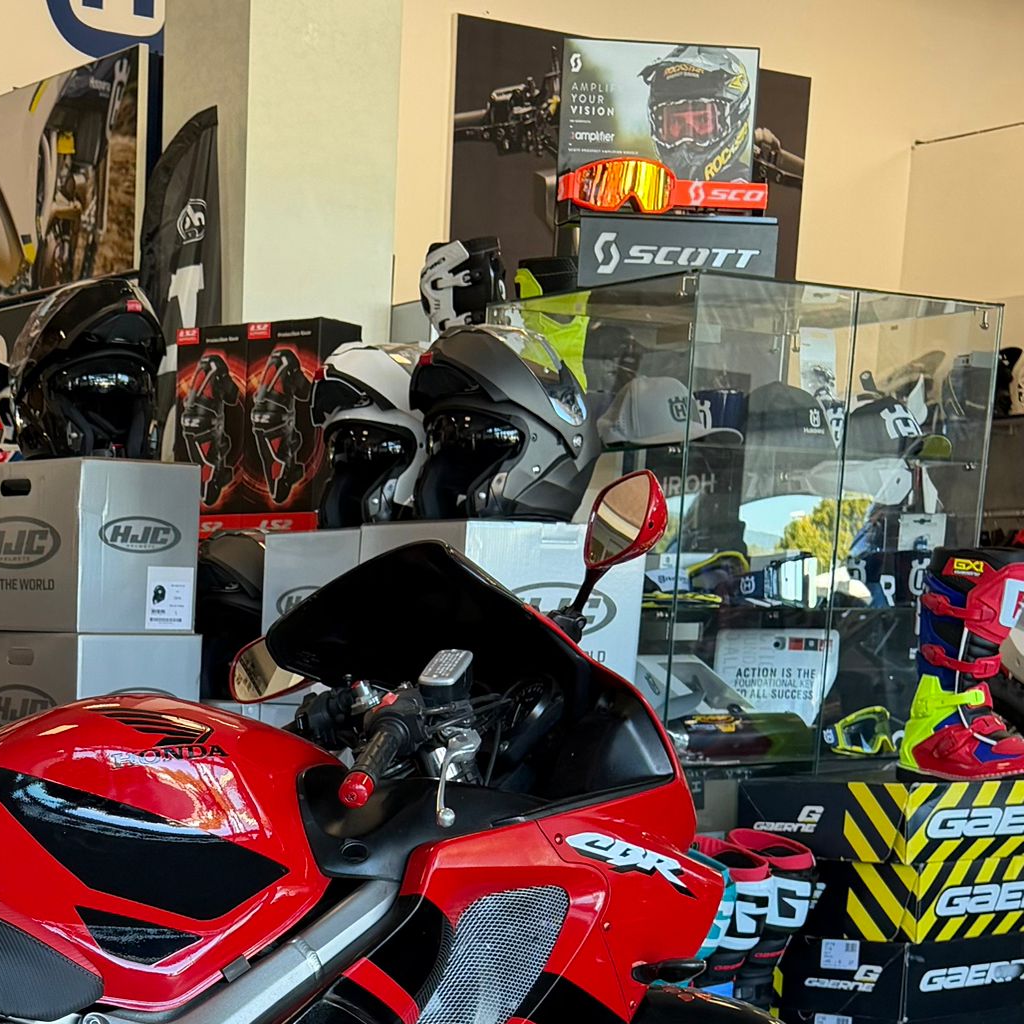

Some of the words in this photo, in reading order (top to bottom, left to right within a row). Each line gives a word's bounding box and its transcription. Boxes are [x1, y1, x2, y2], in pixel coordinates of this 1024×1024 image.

[571, 93, 604, 103] YOUR
[570, 106, 615, 116] VISION
[575, 131, 615, 142] amplifier
[710, 187, 764, 202] SCO
[624, 245, 760, 268] SCOTT
[662, 473, 716, 498] IROH
[201, 521, 223, 533] S2
[110, 525, 171, 544] HJC
[0, 579, 18, 590] THE
[18, 578, 55, 591] WORLD
[736, 667, 777, 678] ACTION
[781, 668, 792, 678] IS
[797, 668, 816, 679] THE
[734, 678, 797, 688] FOUNDATIONAL
[749, 689, 766, 699] ALL
[770, 689, 814, 700] SUCCESS
[110, 744, 229, 771] HONDA
[753, 821, 817, 833] GAERNE
[565, 831, 692, 892] CBR
[935, 882, 1024, 917] GAE
[804, 977, 876, 993] GAERNE
